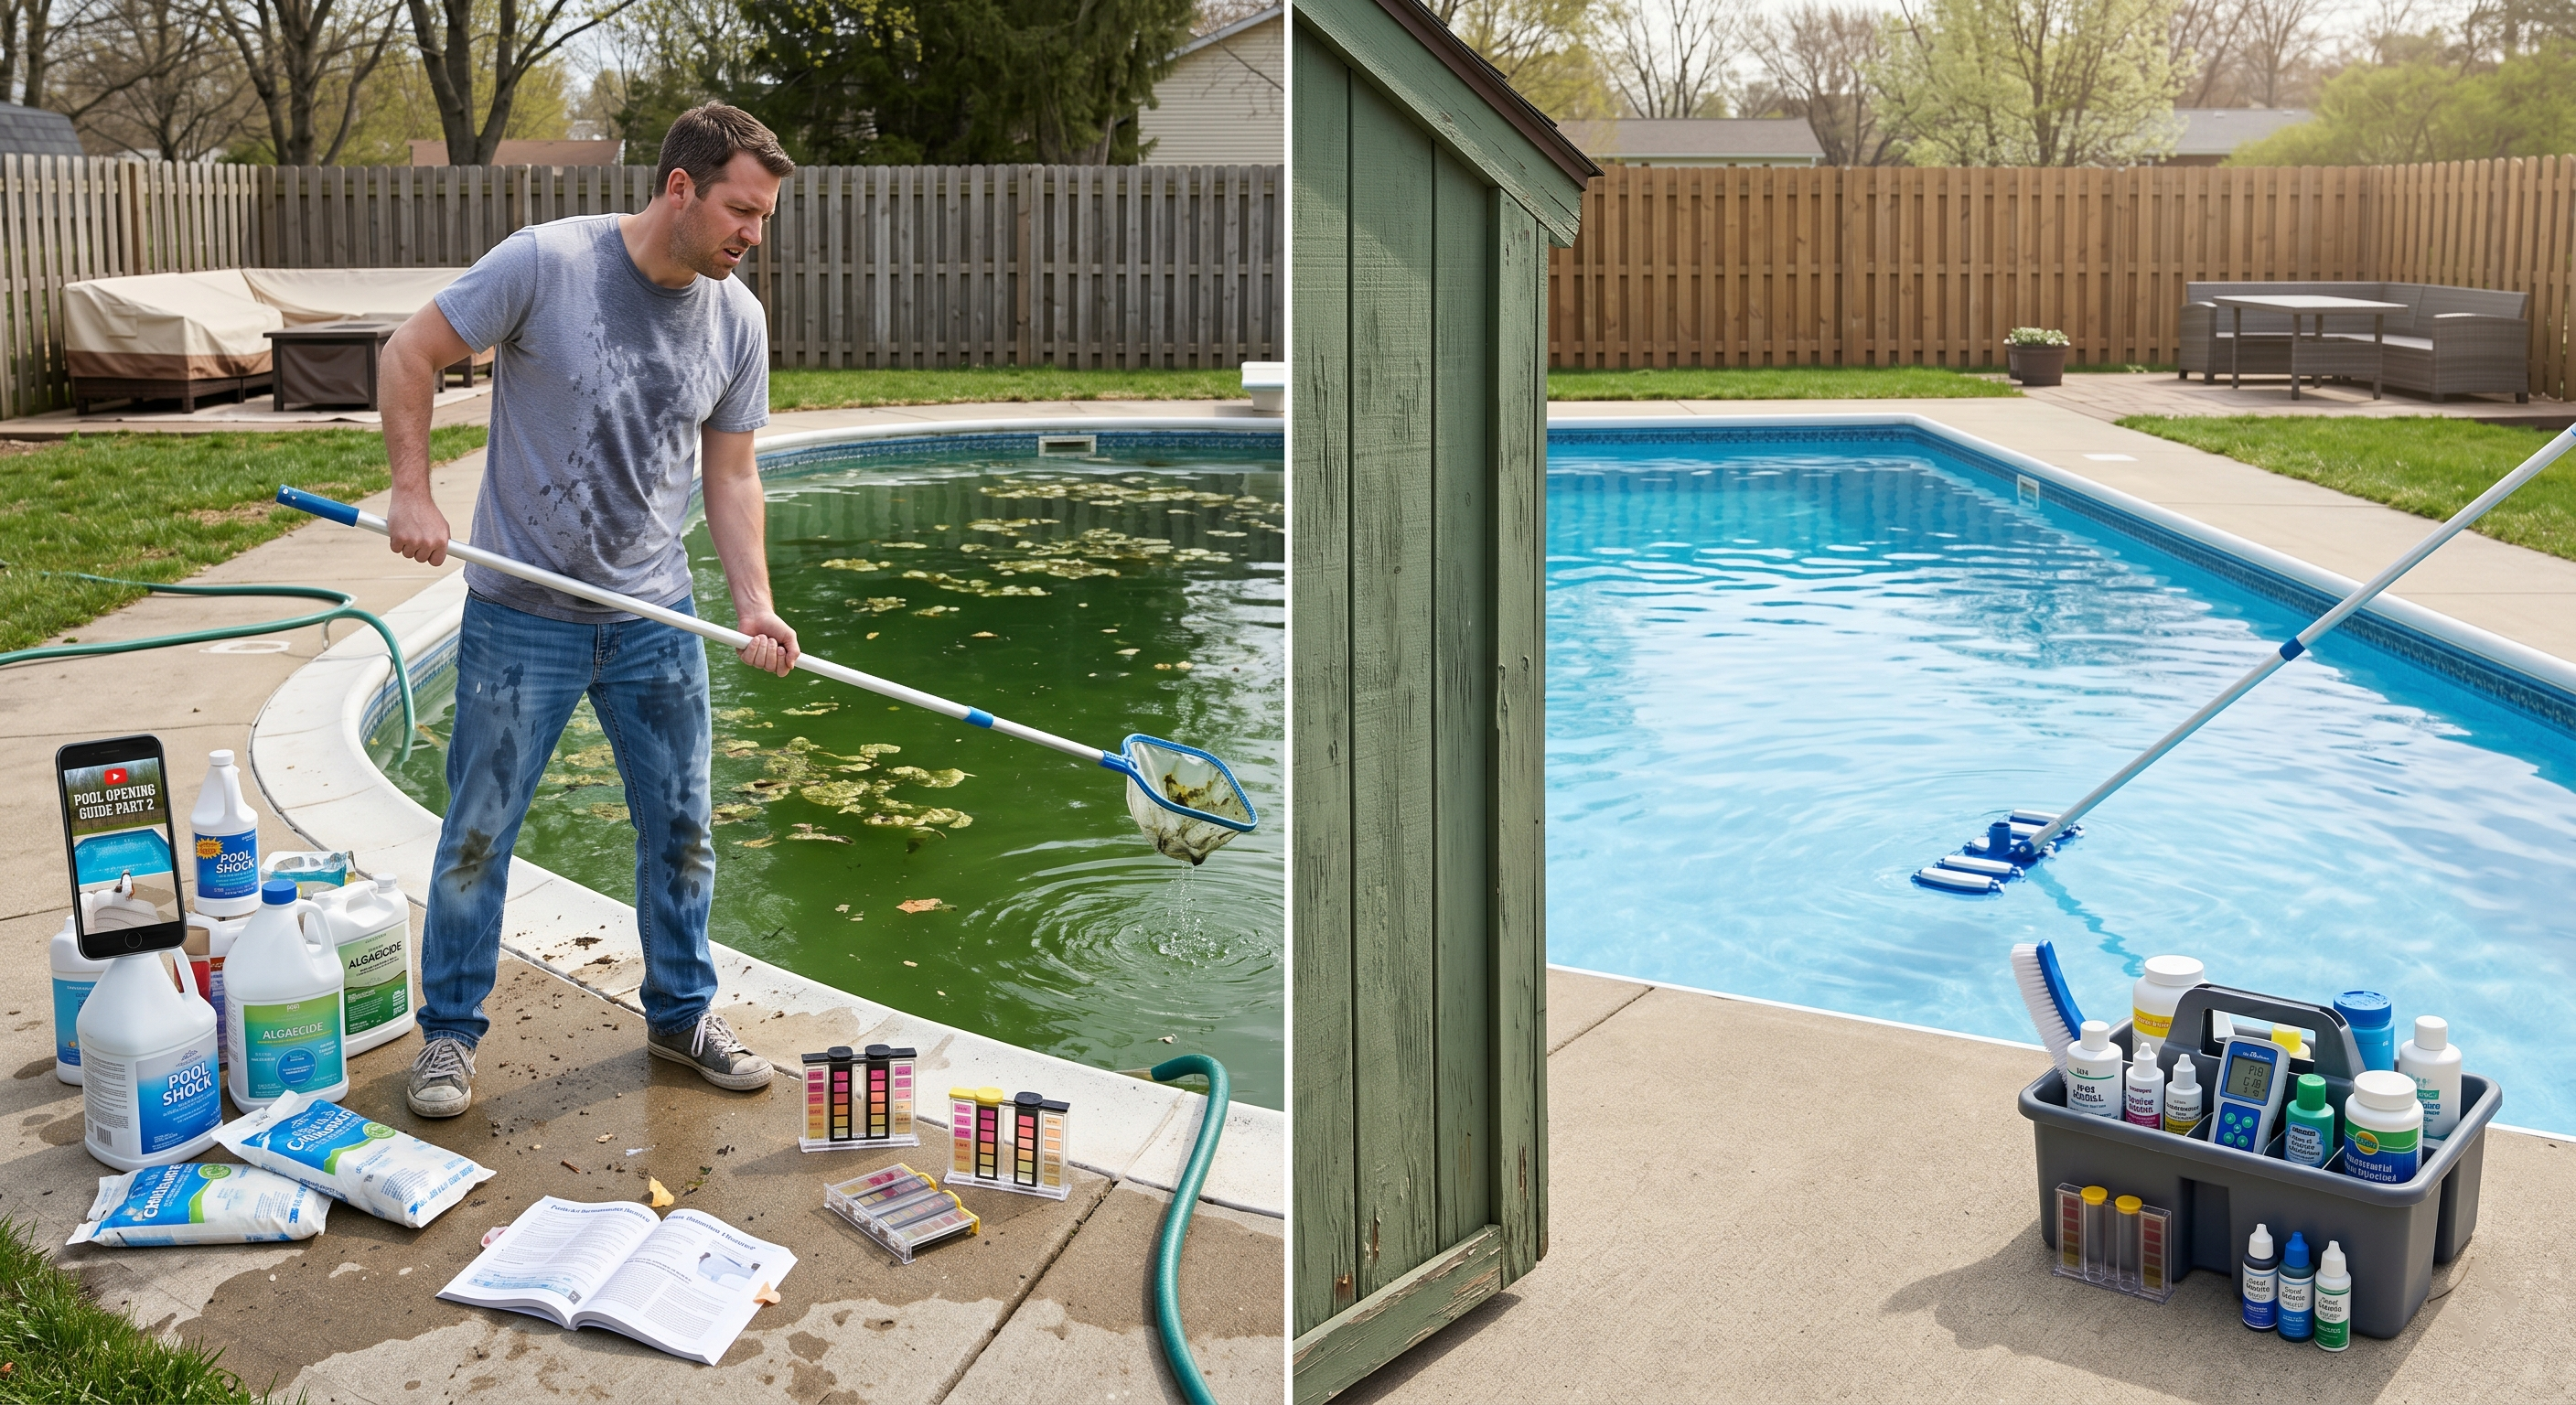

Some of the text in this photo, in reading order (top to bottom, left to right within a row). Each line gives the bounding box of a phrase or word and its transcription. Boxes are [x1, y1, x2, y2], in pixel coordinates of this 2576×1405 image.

[74, 784, 156, 806] POOL OPENING
[80, 799, 154, 820] GUIDE PART 2
[216, 858, 254, 874] SHOCK
[220, 850, 251, 863] POOL
[263, 1022, 323, 1039] ALGAECIDE
[168, 1061, 209, 1089] POOL
[162, 1073, 212, 1106] SHOCK
